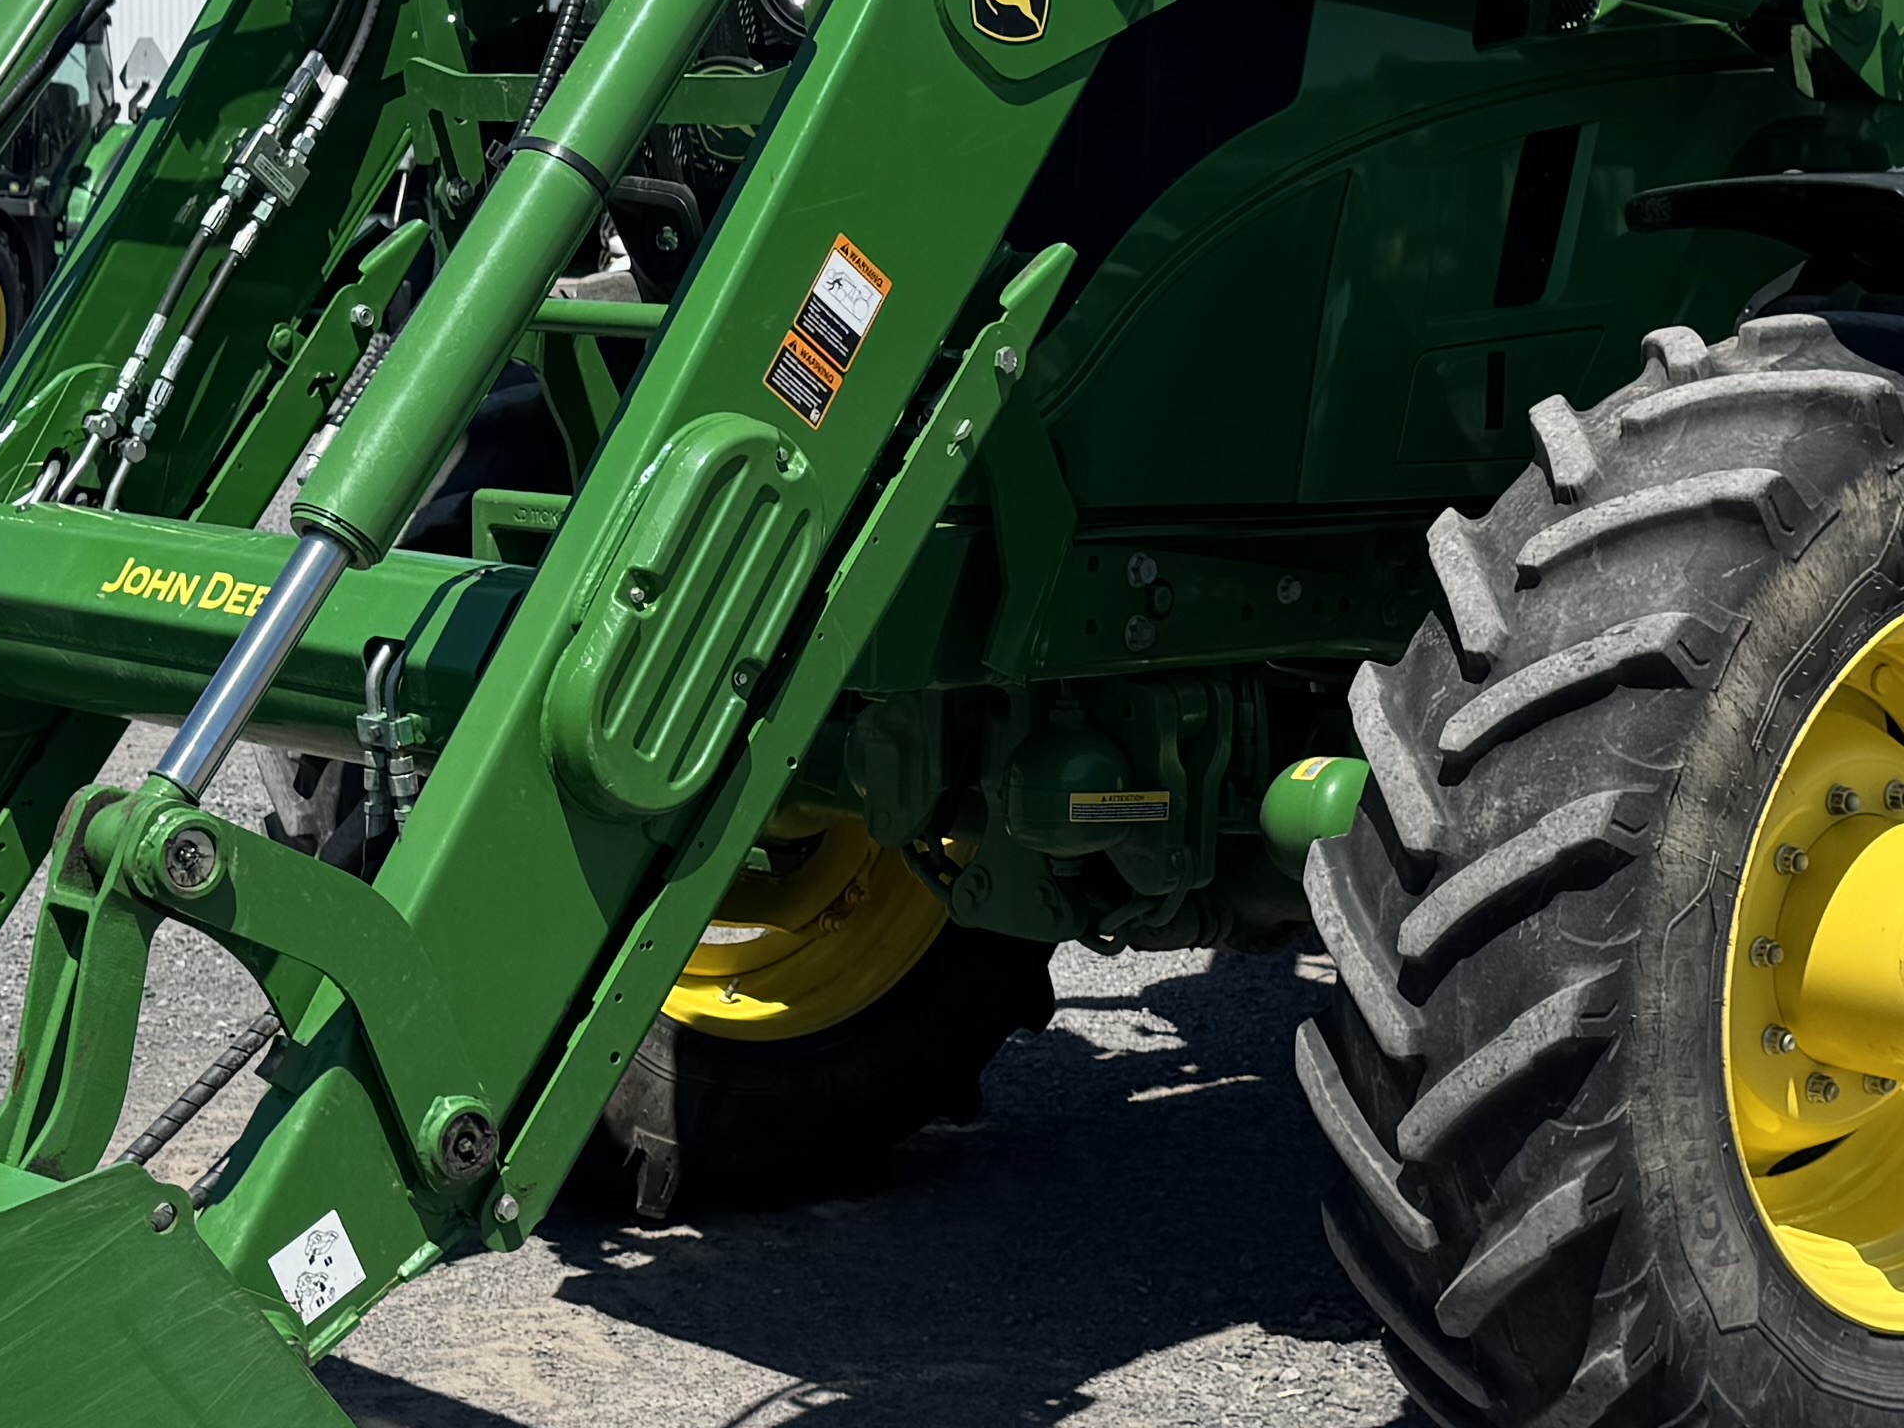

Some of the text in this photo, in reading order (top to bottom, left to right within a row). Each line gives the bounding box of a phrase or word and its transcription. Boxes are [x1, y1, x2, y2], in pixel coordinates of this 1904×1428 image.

[849, 250, 884, 288] WARNING
[799, 348, 835, 386] WARNING
[101, 557, 272, 617] JOHN DEE
